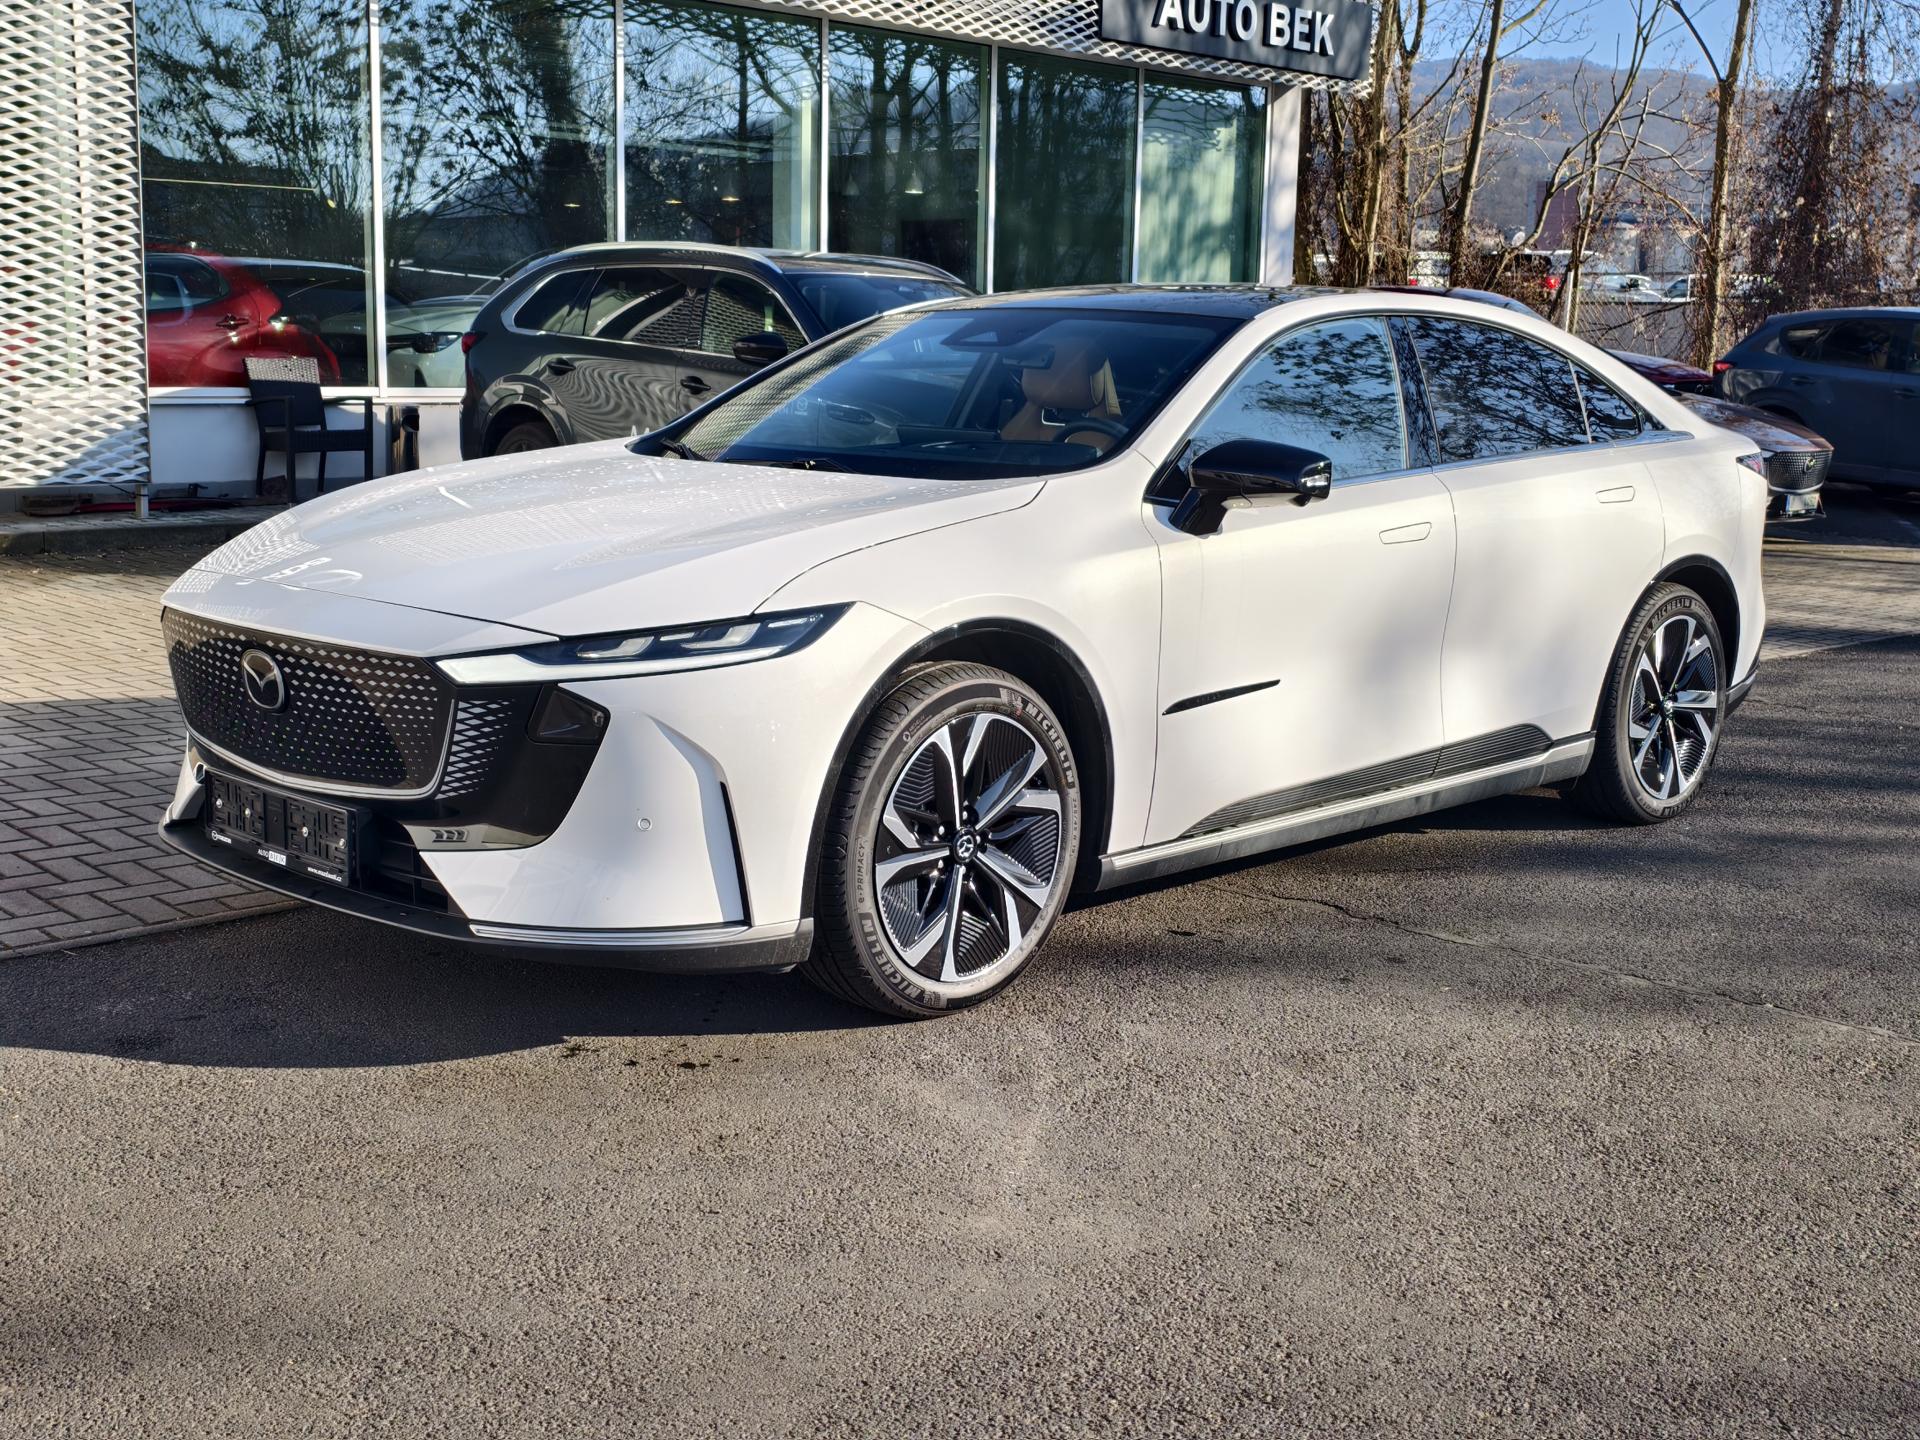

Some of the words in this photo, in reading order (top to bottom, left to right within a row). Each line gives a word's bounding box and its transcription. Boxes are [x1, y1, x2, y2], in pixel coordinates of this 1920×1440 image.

[1158, 0, 1257, 41] AUTO
[1270, 3, 1334, 56] BEK
[1652, 597, 1692, 627] MICHELIN
[1025, 702, 1075, 783] MICHELIN
[861, 919, 921, 998] MICHELIN
